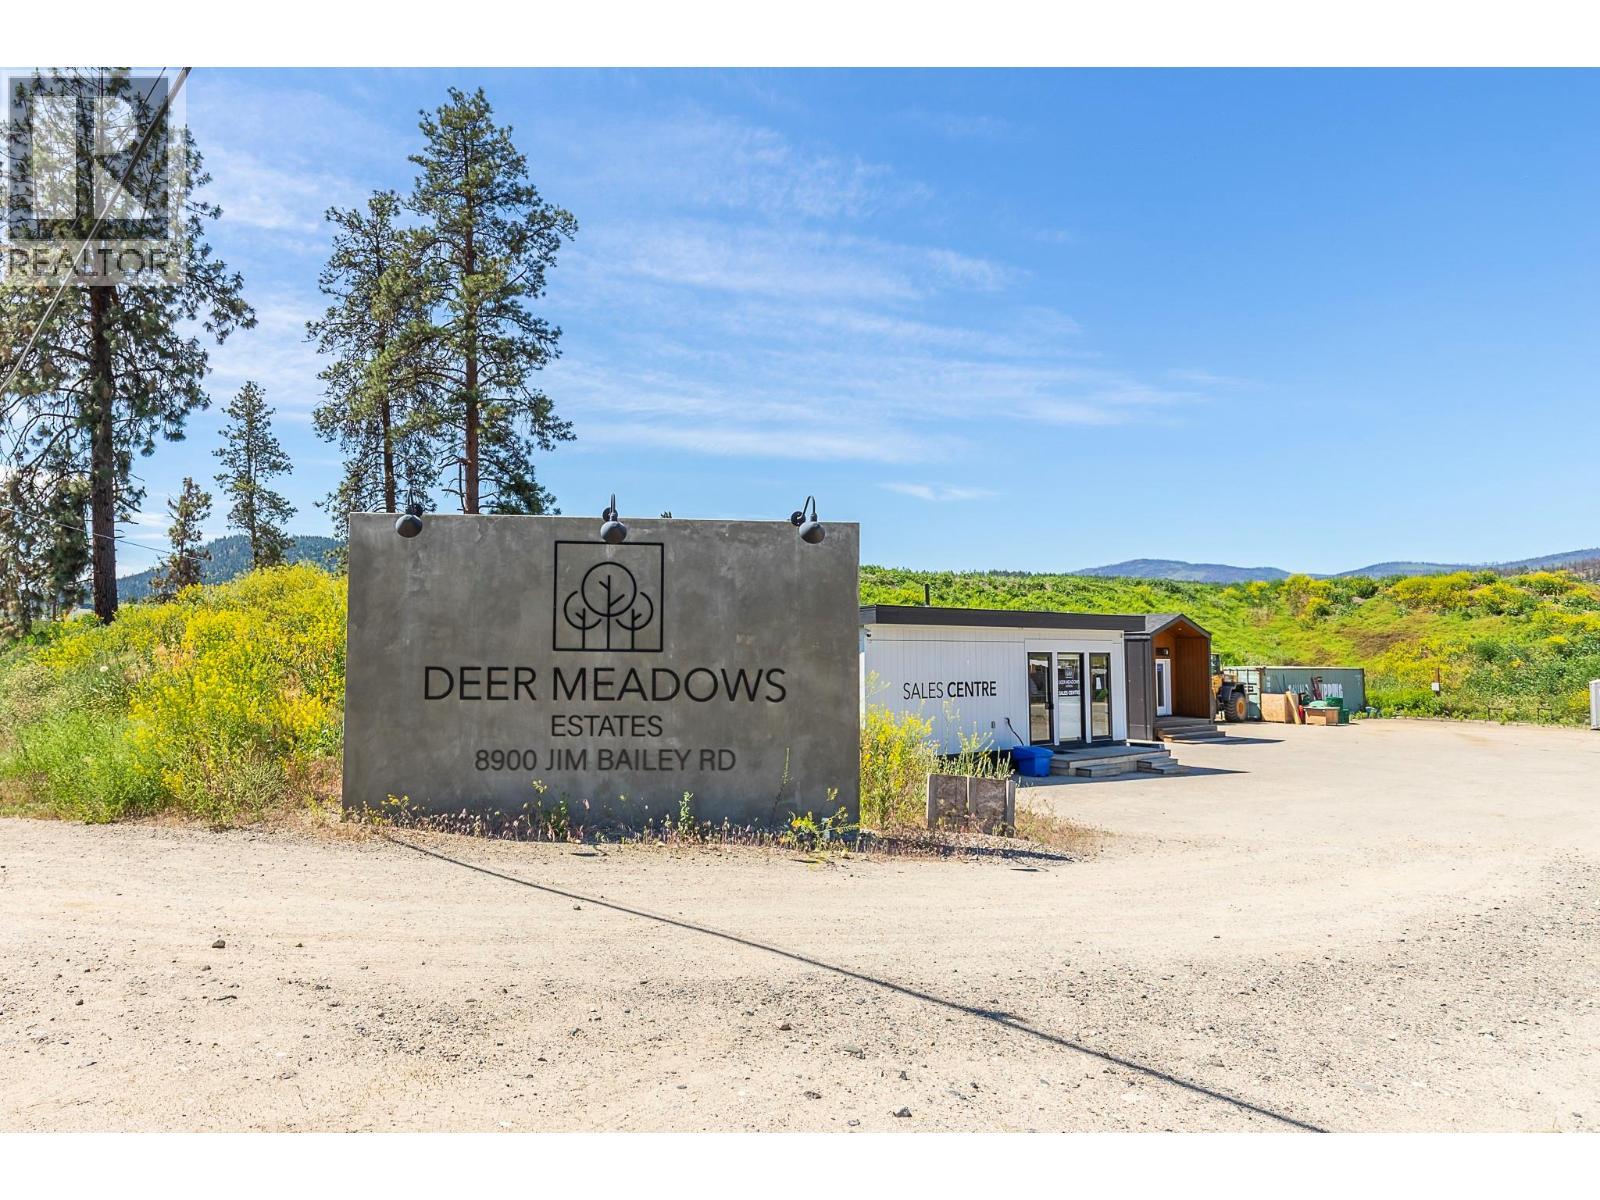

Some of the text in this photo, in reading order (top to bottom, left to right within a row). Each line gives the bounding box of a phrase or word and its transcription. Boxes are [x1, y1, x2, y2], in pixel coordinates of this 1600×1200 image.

[423, 666, 787, 703] DEER MEADOWS
[903, 681, 997, 700] SALES CENTRE
[550, 715, 664, 737] ESTATES
[474, 749, 736, 771] 8900 JIM BAILEY RD
